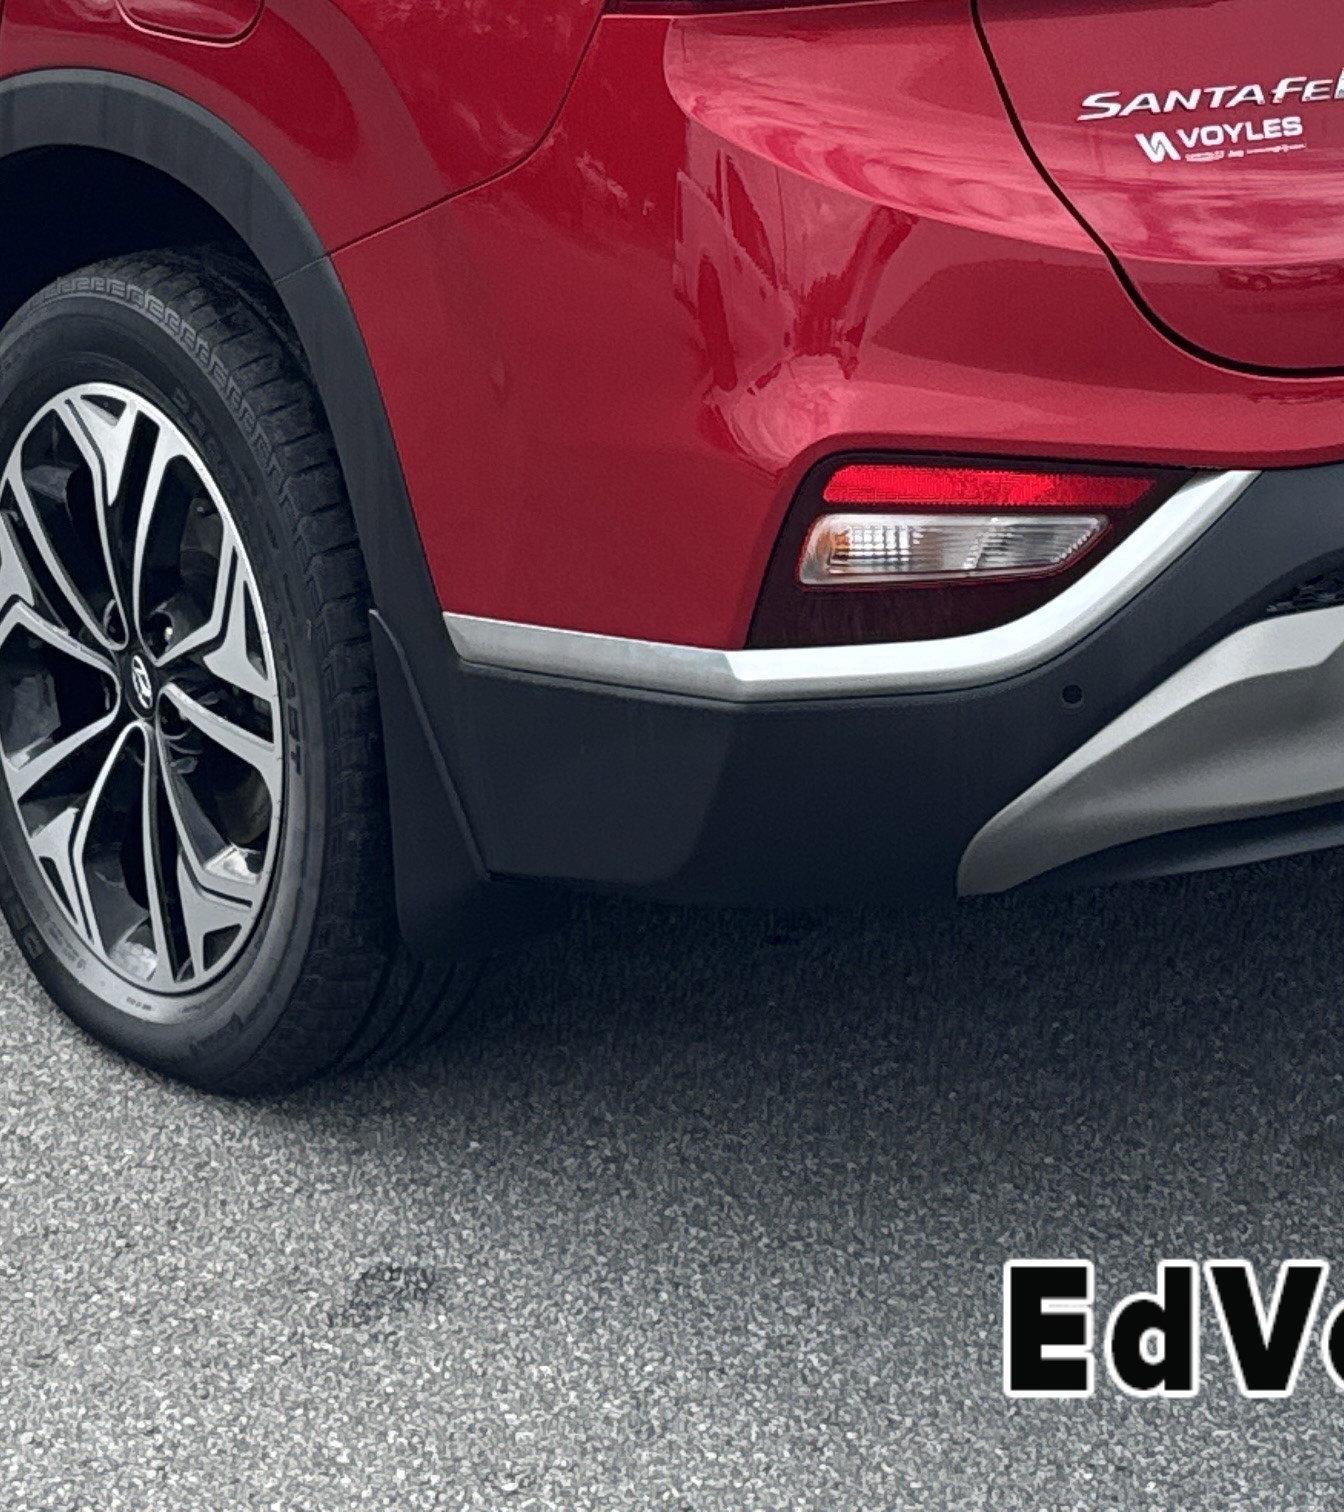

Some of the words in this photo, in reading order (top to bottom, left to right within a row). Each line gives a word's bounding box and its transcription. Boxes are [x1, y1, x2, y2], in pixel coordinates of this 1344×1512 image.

[1076, 83, 1266, 122] SANTA
[1271, 76, 1334, 104] FE
[1176, 115, 1304, 148] VOYLES
